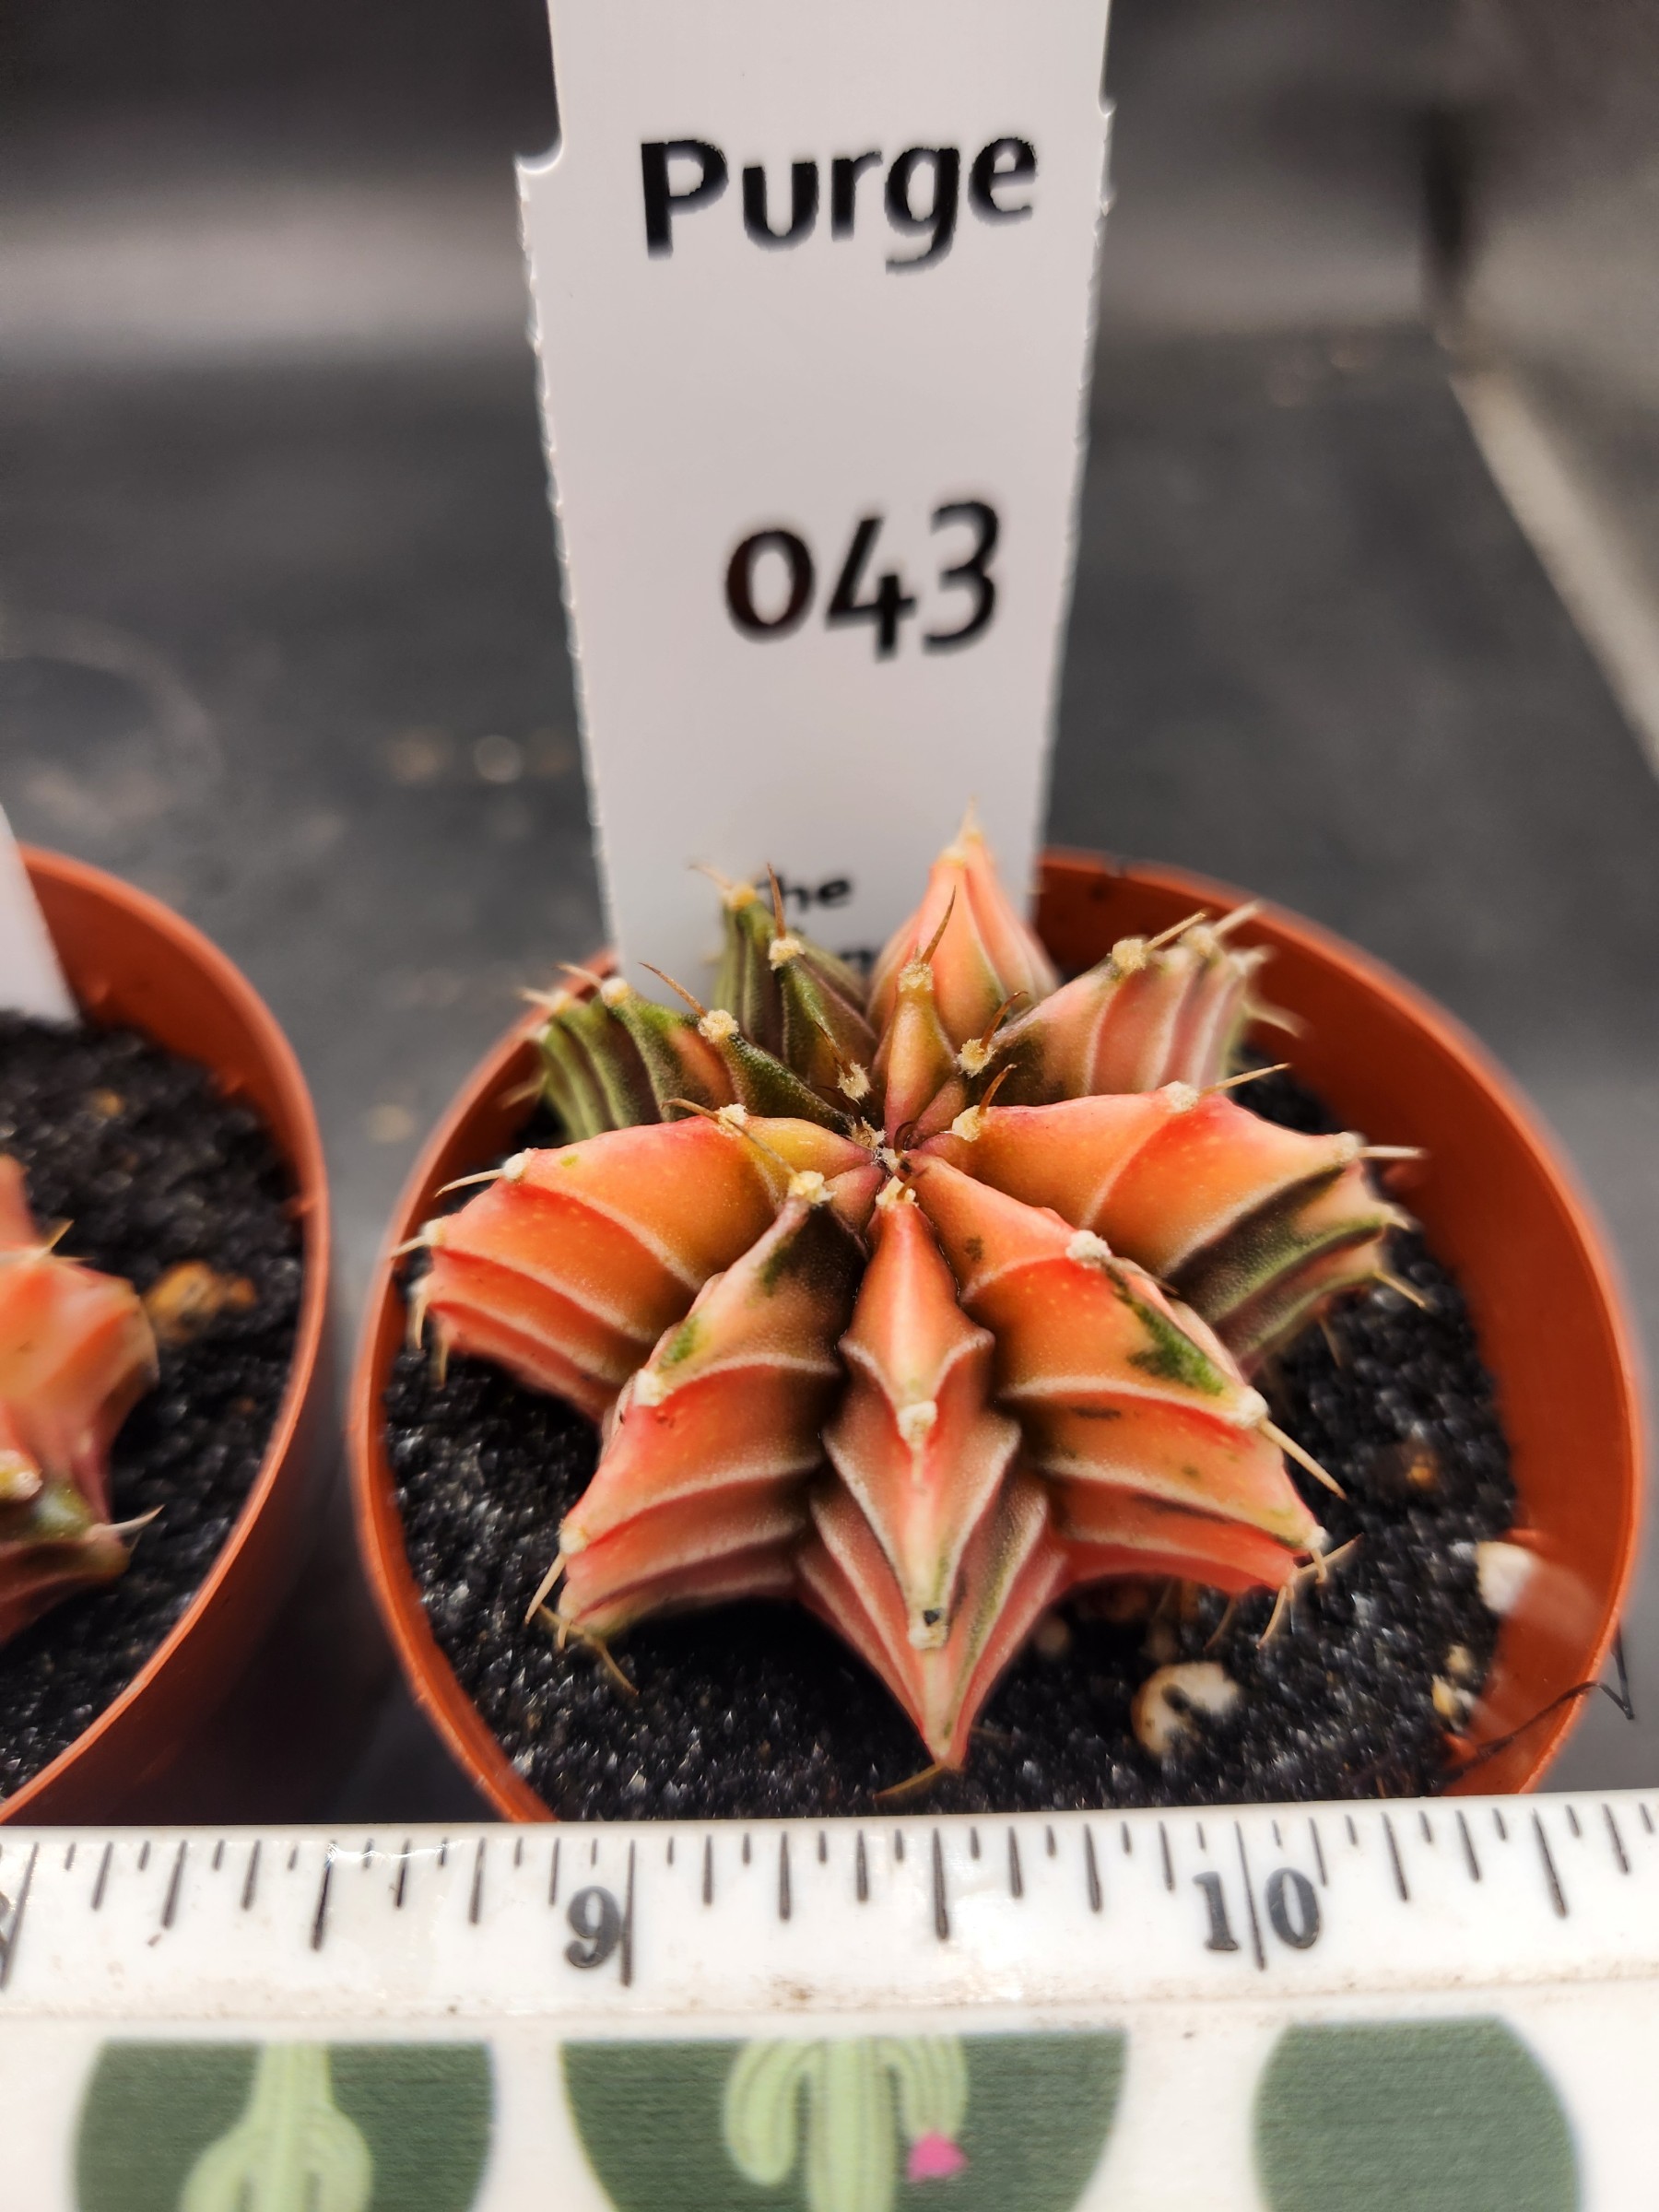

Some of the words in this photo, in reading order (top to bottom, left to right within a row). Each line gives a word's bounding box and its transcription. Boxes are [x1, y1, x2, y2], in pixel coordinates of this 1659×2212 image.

[641, 136, 1039, 275] Purge
[724, 500, 1000, 664] 043
[565, 1885, 622, 1969] 9
[1193, 1867, 1321, 1950] 10
